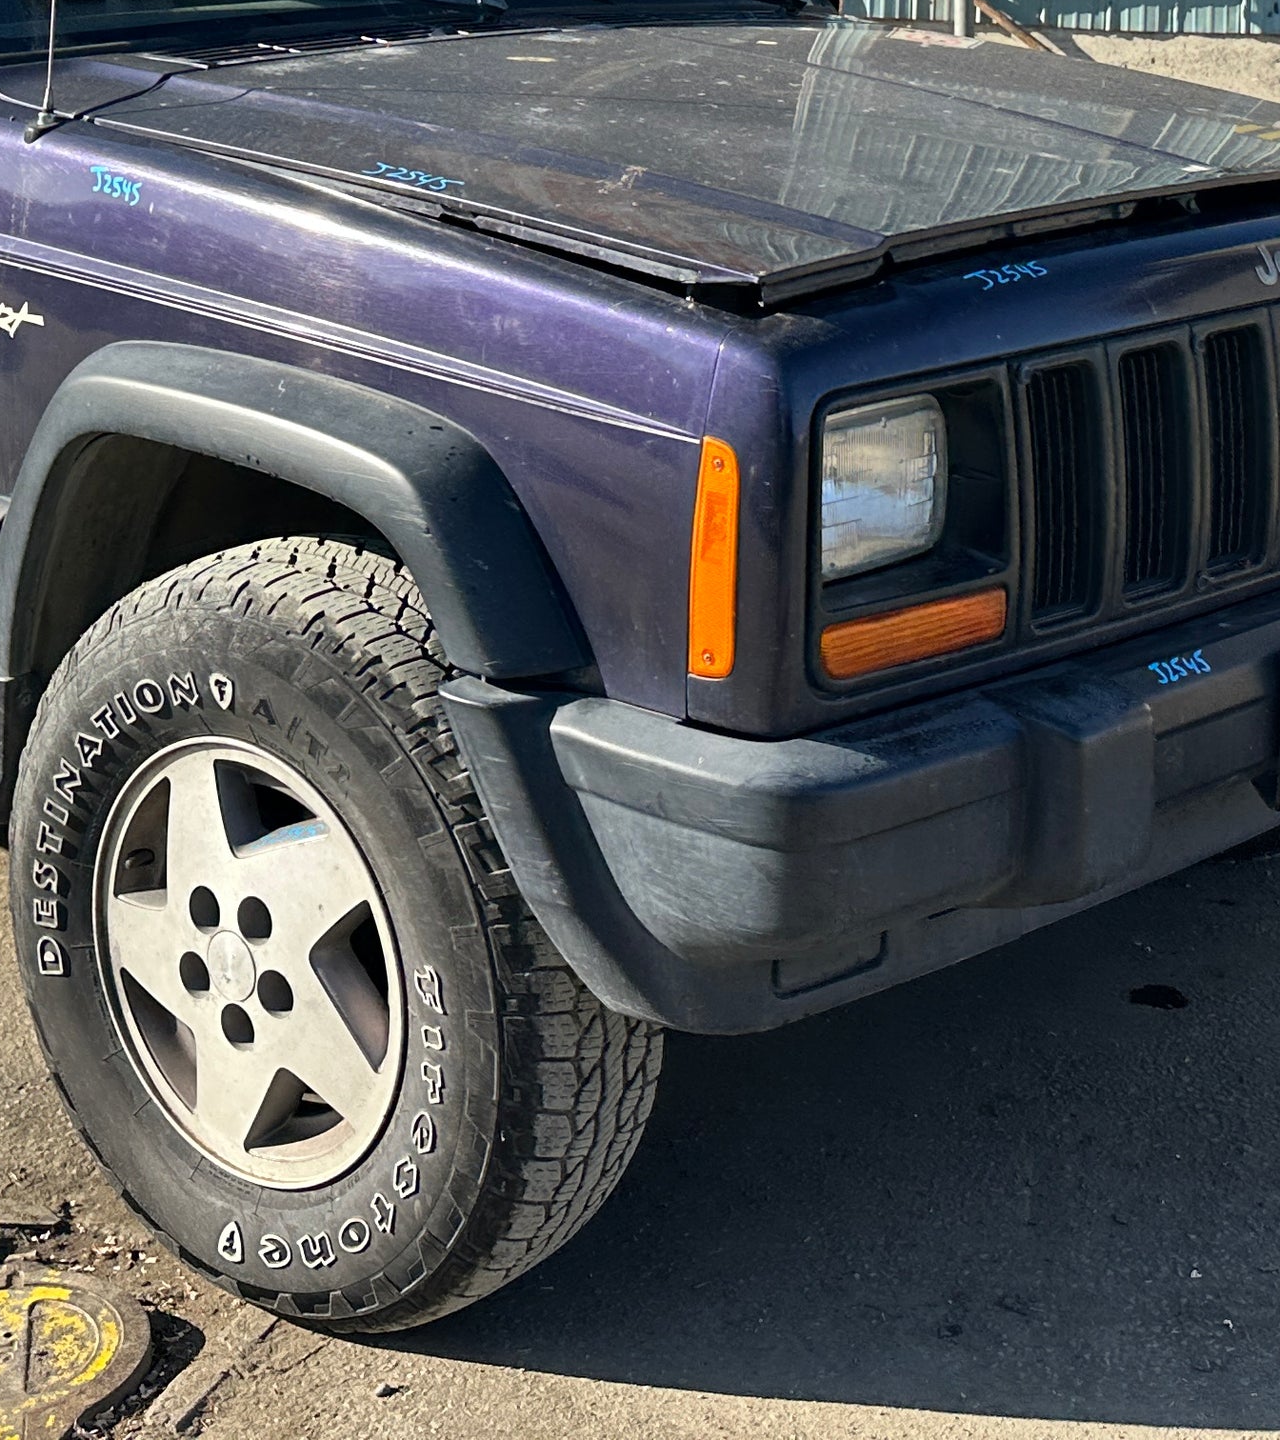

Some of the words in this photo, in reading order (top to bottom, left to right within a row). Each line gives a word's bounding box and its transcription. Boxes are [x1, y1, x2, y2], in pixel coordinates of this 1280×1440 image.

[89, 165, 142, 208] J2545
[963, 260, 1049, 291] J2545
[1147, 648, 1212, 685] J2545
[33, 670, 200, 977] DESTINATION
[257, 964, 448, 1270] Firestone
